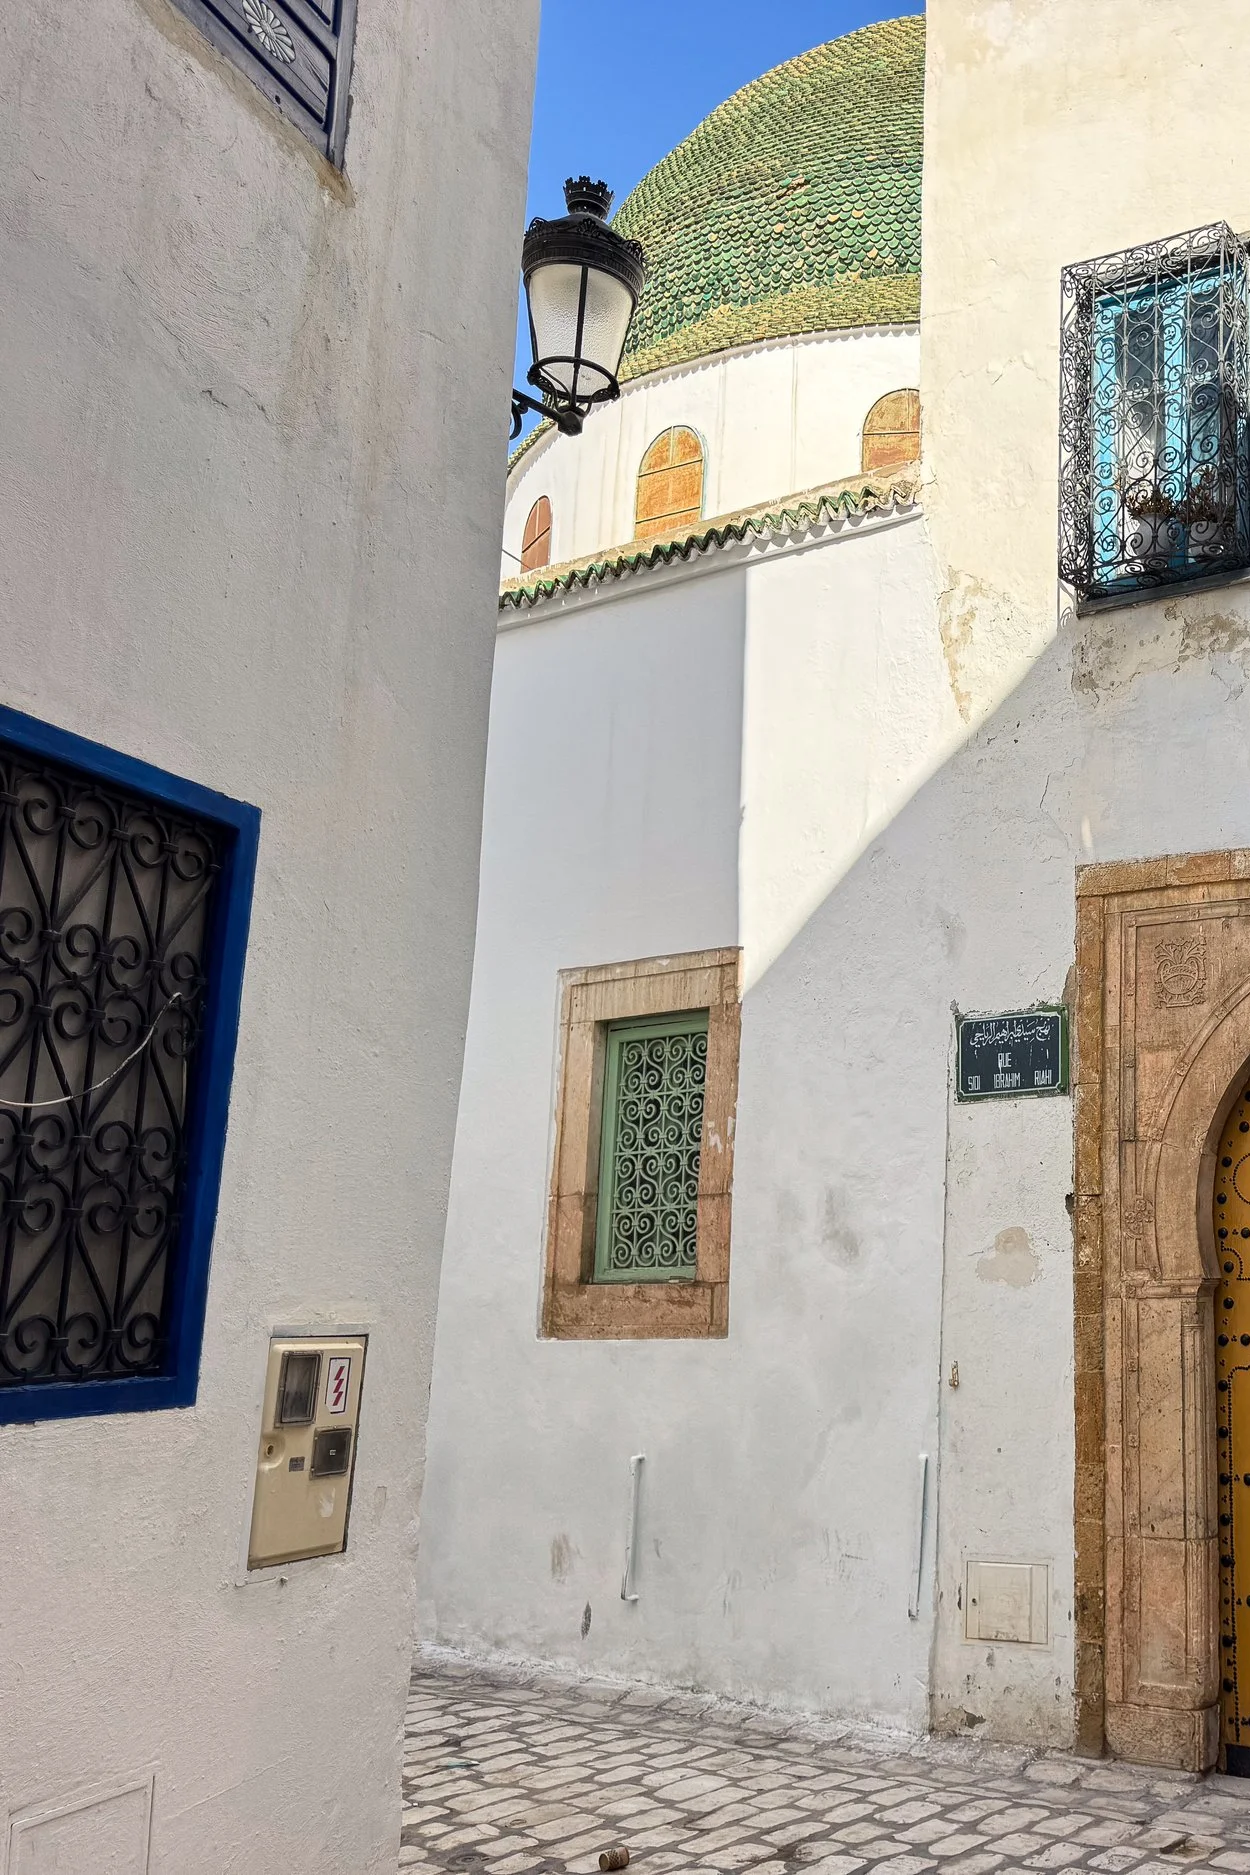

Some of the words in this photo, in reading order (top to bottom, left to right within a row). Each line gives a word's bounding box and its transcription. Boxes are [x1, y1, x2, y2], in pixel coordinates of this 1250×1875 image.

[998, 1053, 1012, 1068] RUE
[968, 1075, 981, 1091] SIDI
[993, 1072, 1021, 1089] IBRAHIM
[1034, 1069, 1052, 1086] RIAHI
